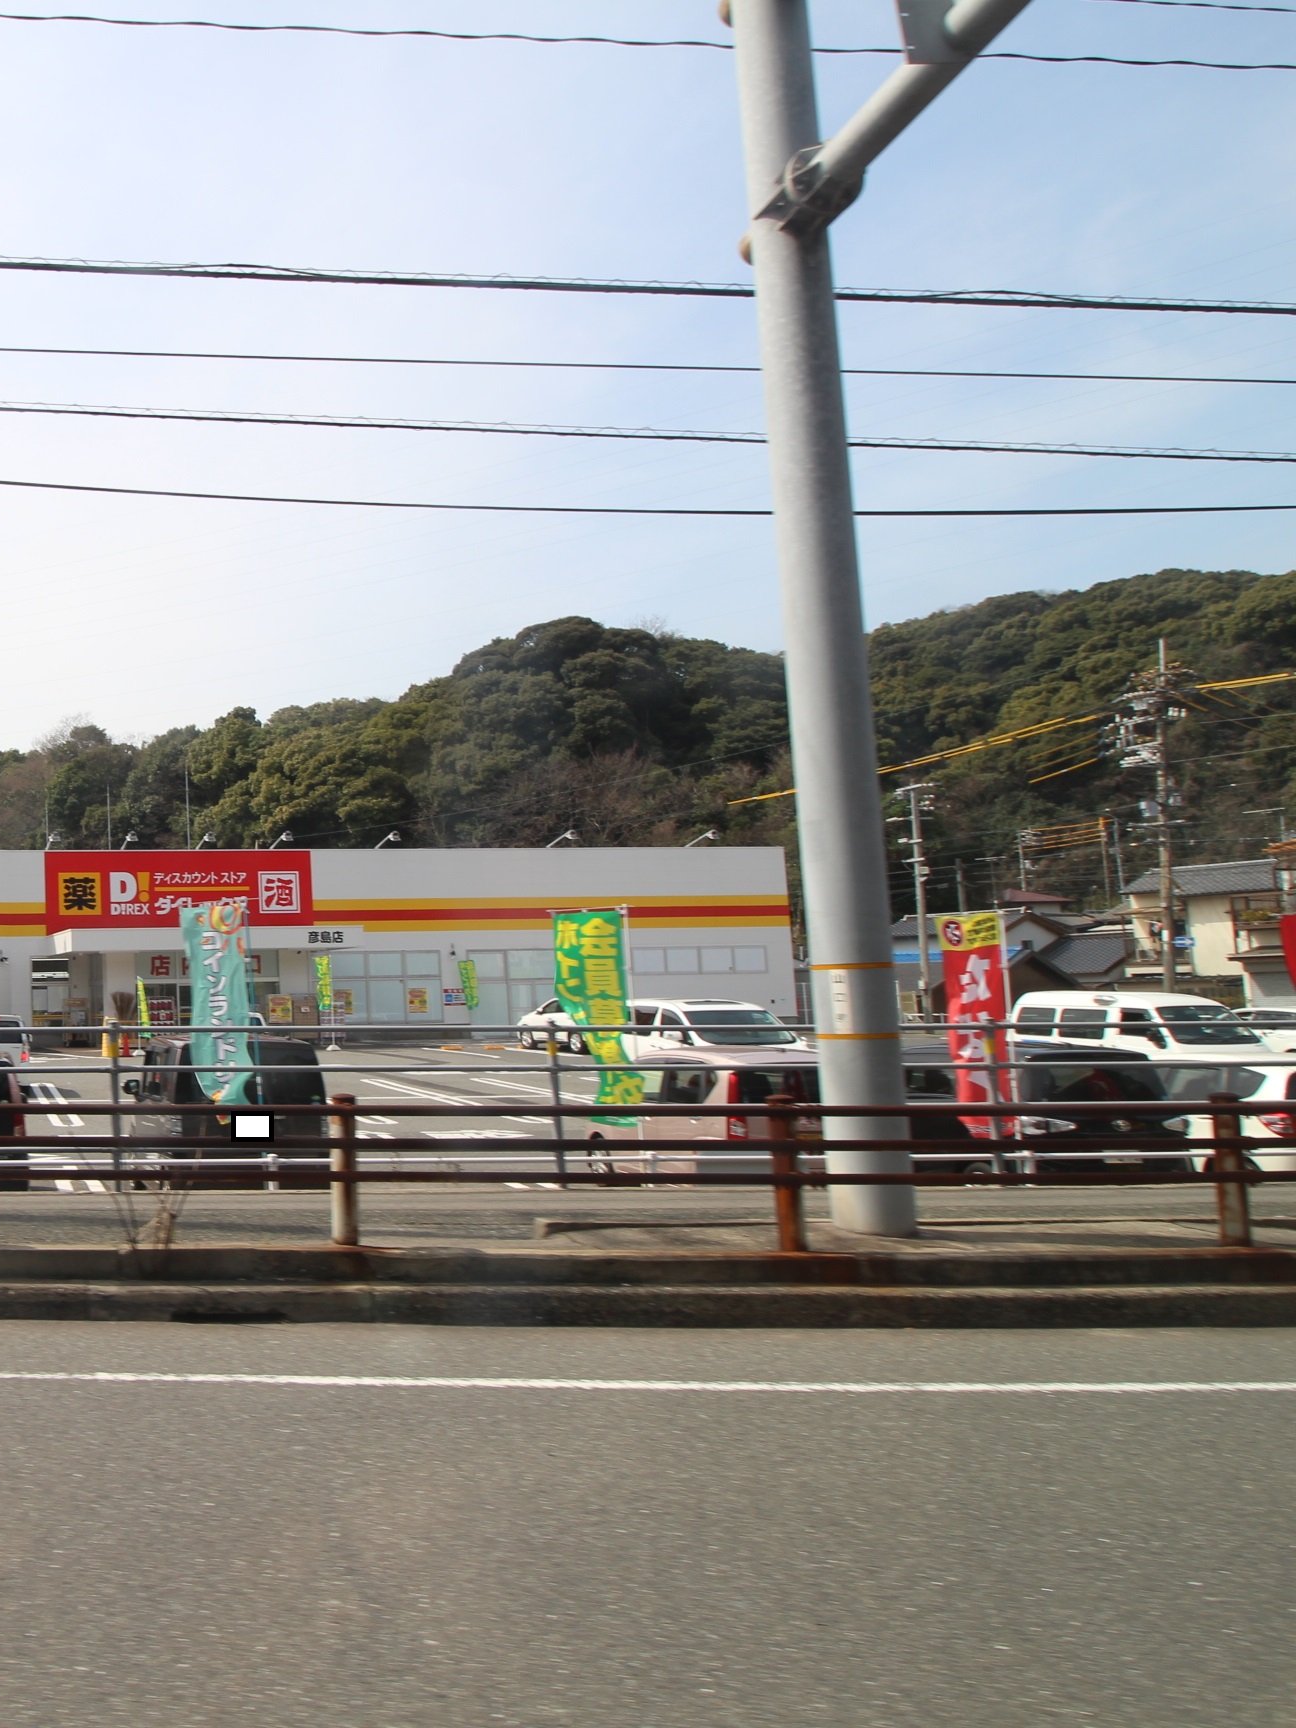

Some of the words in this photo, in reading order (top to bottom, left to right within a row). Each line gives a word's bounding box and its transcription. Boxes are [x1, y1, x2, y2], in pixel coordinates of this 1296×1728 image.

[153, 872, 218, 884] ディスカウント
[220, 871, 247, 884] ストア
[63, 877, 96, 911] 薬
[264, 878, 294, 908] 酒
[308, 931, 344, 943] 彦島店
